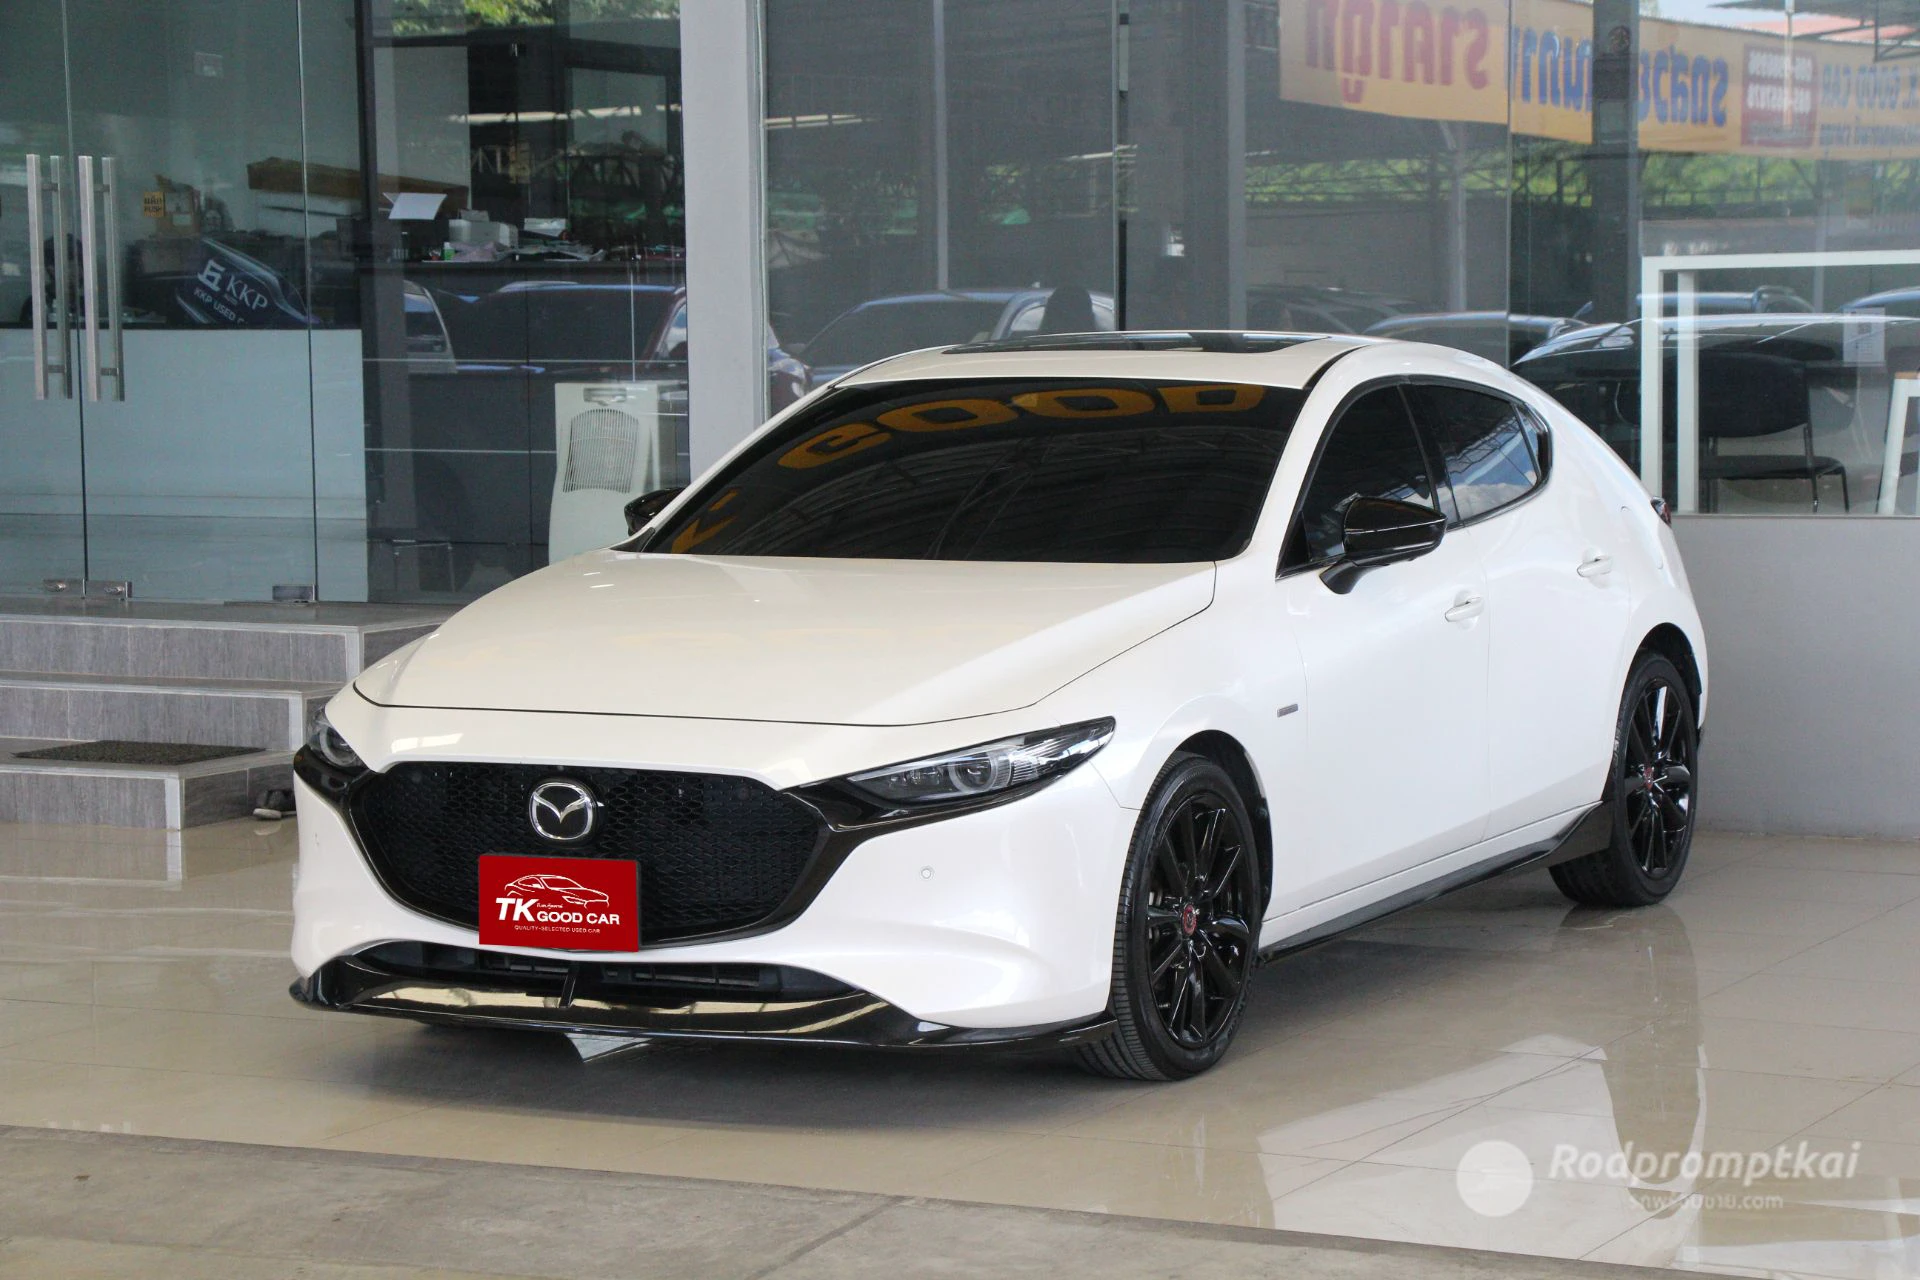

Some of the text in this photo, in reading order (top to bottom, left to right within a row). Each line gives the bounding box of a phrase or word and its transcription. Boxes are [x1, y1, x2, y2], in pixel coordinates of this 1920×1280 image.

[226, 274, 268, 310] KKP
[213, 301, 236, 321] USED
[496, 897, 539, 922] TK
[536, 911, 583, 923] GOOD
[586, 913, 620, 925] CAR
